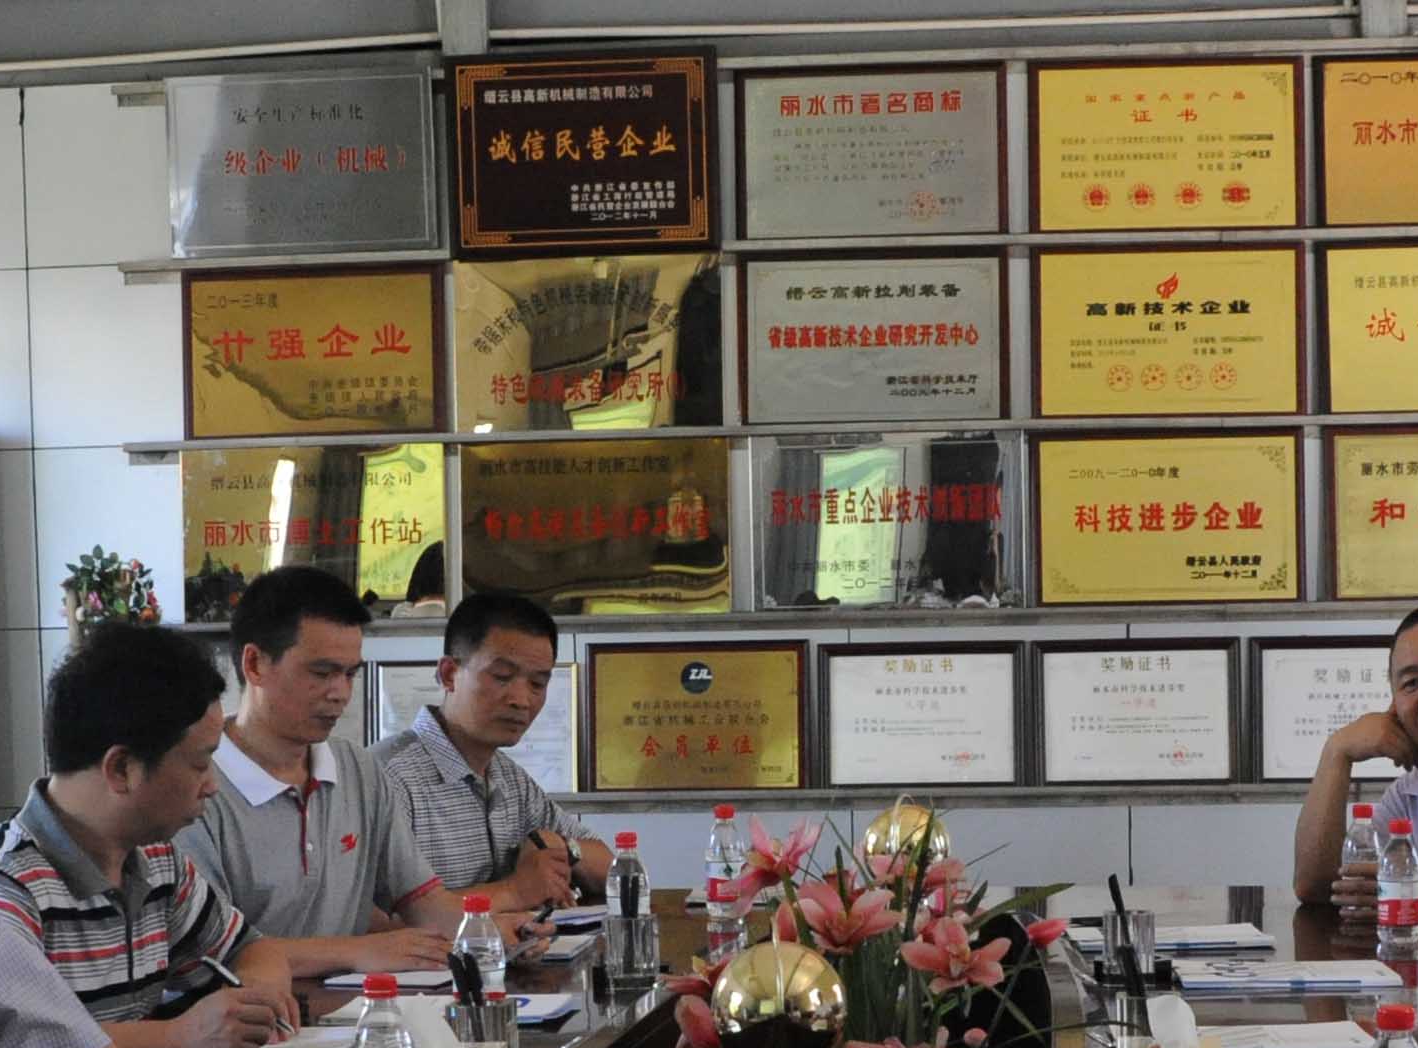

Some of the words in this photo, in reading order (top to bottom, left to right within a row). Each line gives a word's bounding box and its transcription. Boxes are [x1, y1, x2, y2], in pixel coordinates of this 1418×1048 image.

[781, 90, 963, 117] 丽水市著名商标
[1132, 108, 1198, 123] 证书
[488, 124, 677, 164] 诚信民营企业
[1086, 300, 1253, 317] 高新技术企业
[212, 321, 414, 368] 廿强企业
[769, 323, 979, 350] 省级高新技术企业研究开发中心
[1075, 501, 1263, 533] 科技进步企业
